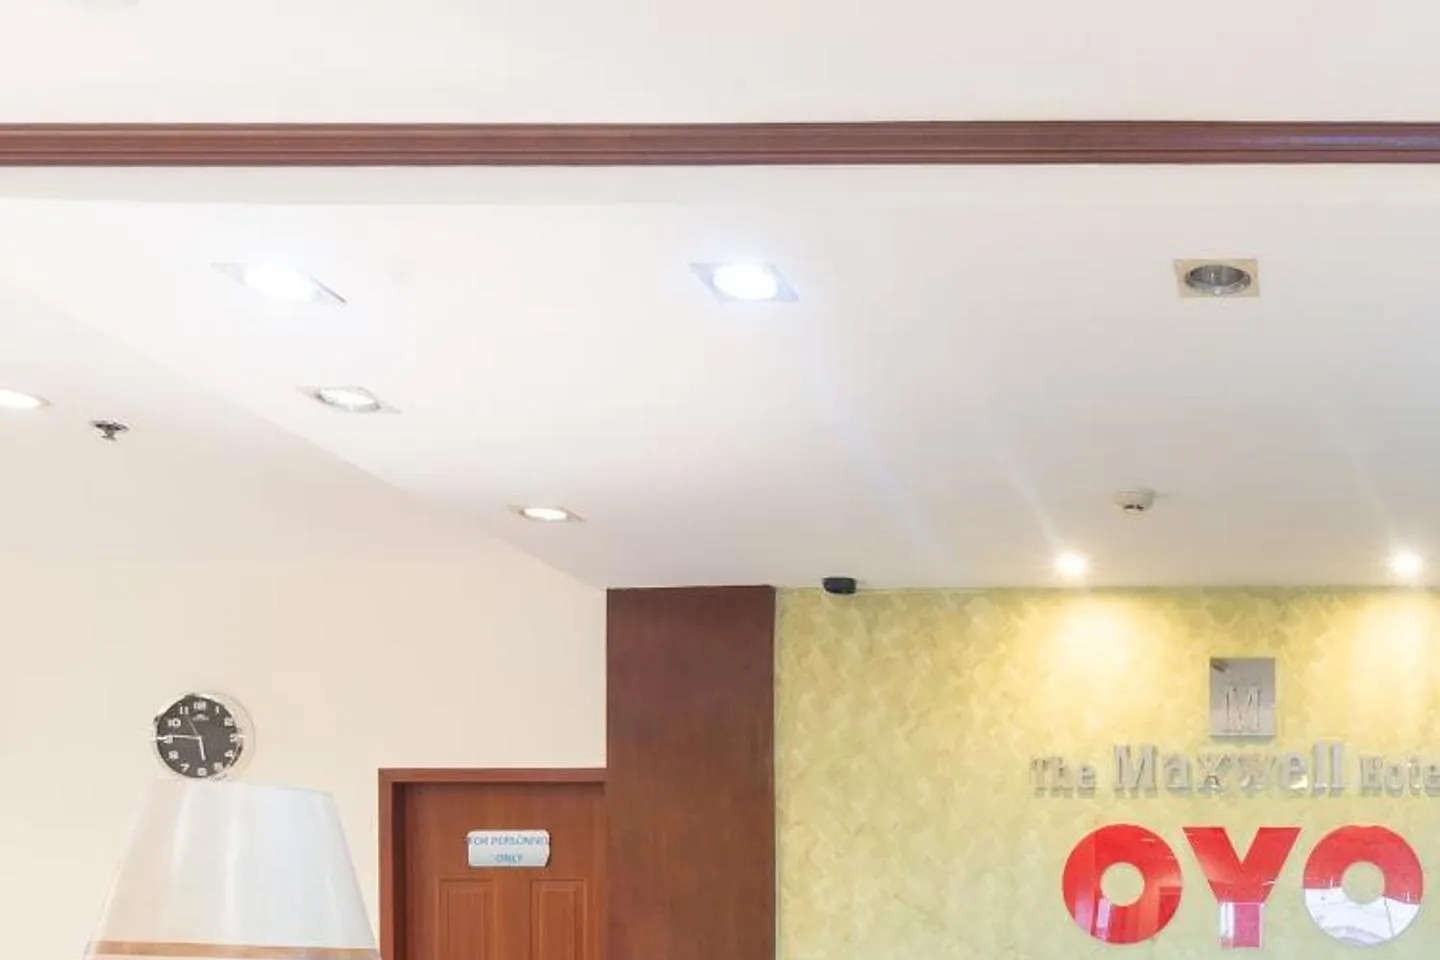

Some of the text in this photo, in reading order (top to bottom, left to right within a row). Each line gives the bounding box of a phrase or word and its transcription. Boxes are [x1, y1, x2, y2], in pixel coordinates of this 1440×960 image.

[1031, 756, 1096, 795] The
[1112, 742, 1345, 795] Maxwell
[1062, 824, 1424, 948] OYO
